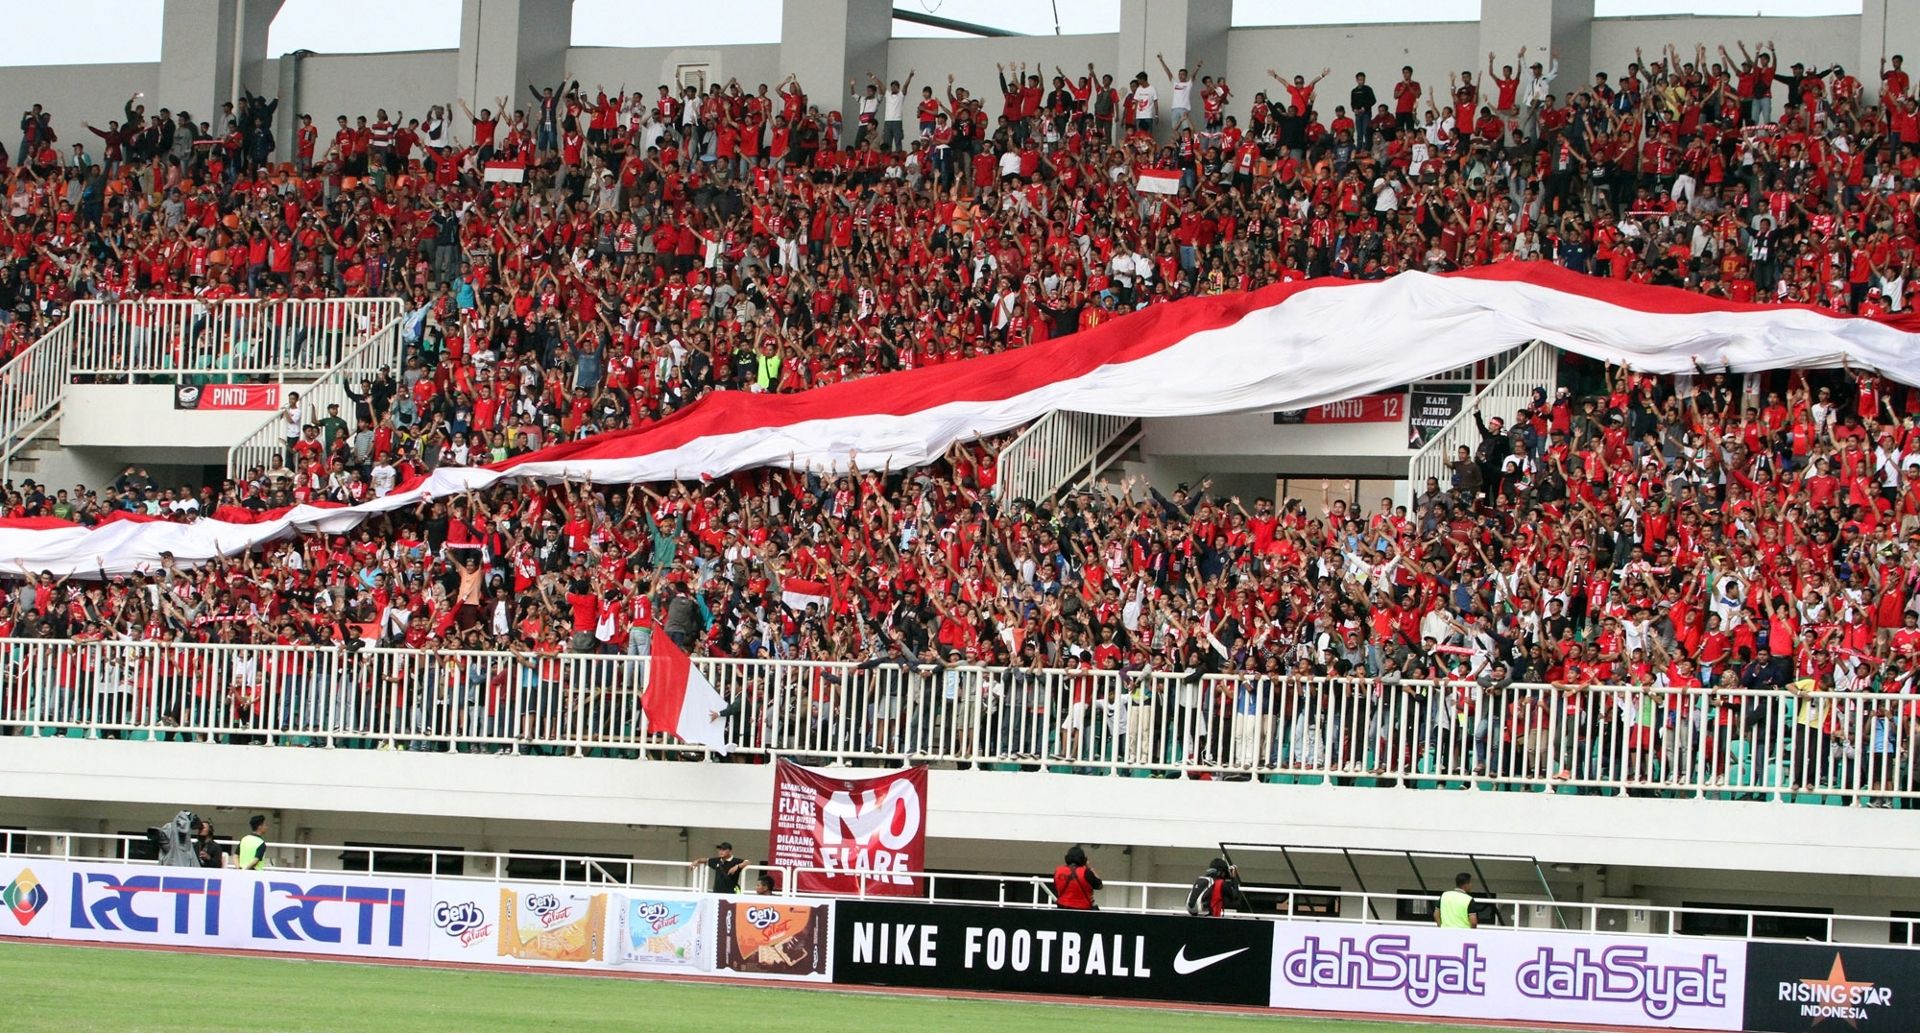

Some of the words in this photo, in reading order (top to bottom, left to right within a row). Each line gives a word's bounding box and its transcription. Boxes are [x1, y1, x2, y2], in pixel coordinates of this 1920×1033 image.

[213, 388, 247, 406] PINTU
[266, 388, 276, 405] 11
[1322, 400, 1363, 418] PINTU
[1383, 398, 1398, 417] 12
[1425, 396, 1448, 405] KAMI
[1422, 407, 1451, 416] RINDU
[779, 797, 816, 816] FLARE
[823, 778, 920, 850] NO
[777, 834, 814, 847] DILARANG
[820, 847, 914, 885] FLARE
[70, 872, 221, 936] RCTI
[252, 881, 405, 947] RCTI
[525, 894, 560, 916] Gery
[639, 902, 669, 923] Gery
[433, 901, 484, 936] Gery
[746, 906, 780, 929] Gery
[852, 921, 938, 967] NIKE
[964, 926, 1150, 978] FOOTBALL
[1283, 934, 1487, 1007] dahSyat
[1516, 945, 1727, 1020] dahSyat
[1778, 981, 1847, 1004] RISING
[1850, 986, 1892, 1006] STAR
[1800, 1004, 1868, 1020] INDONESIA
